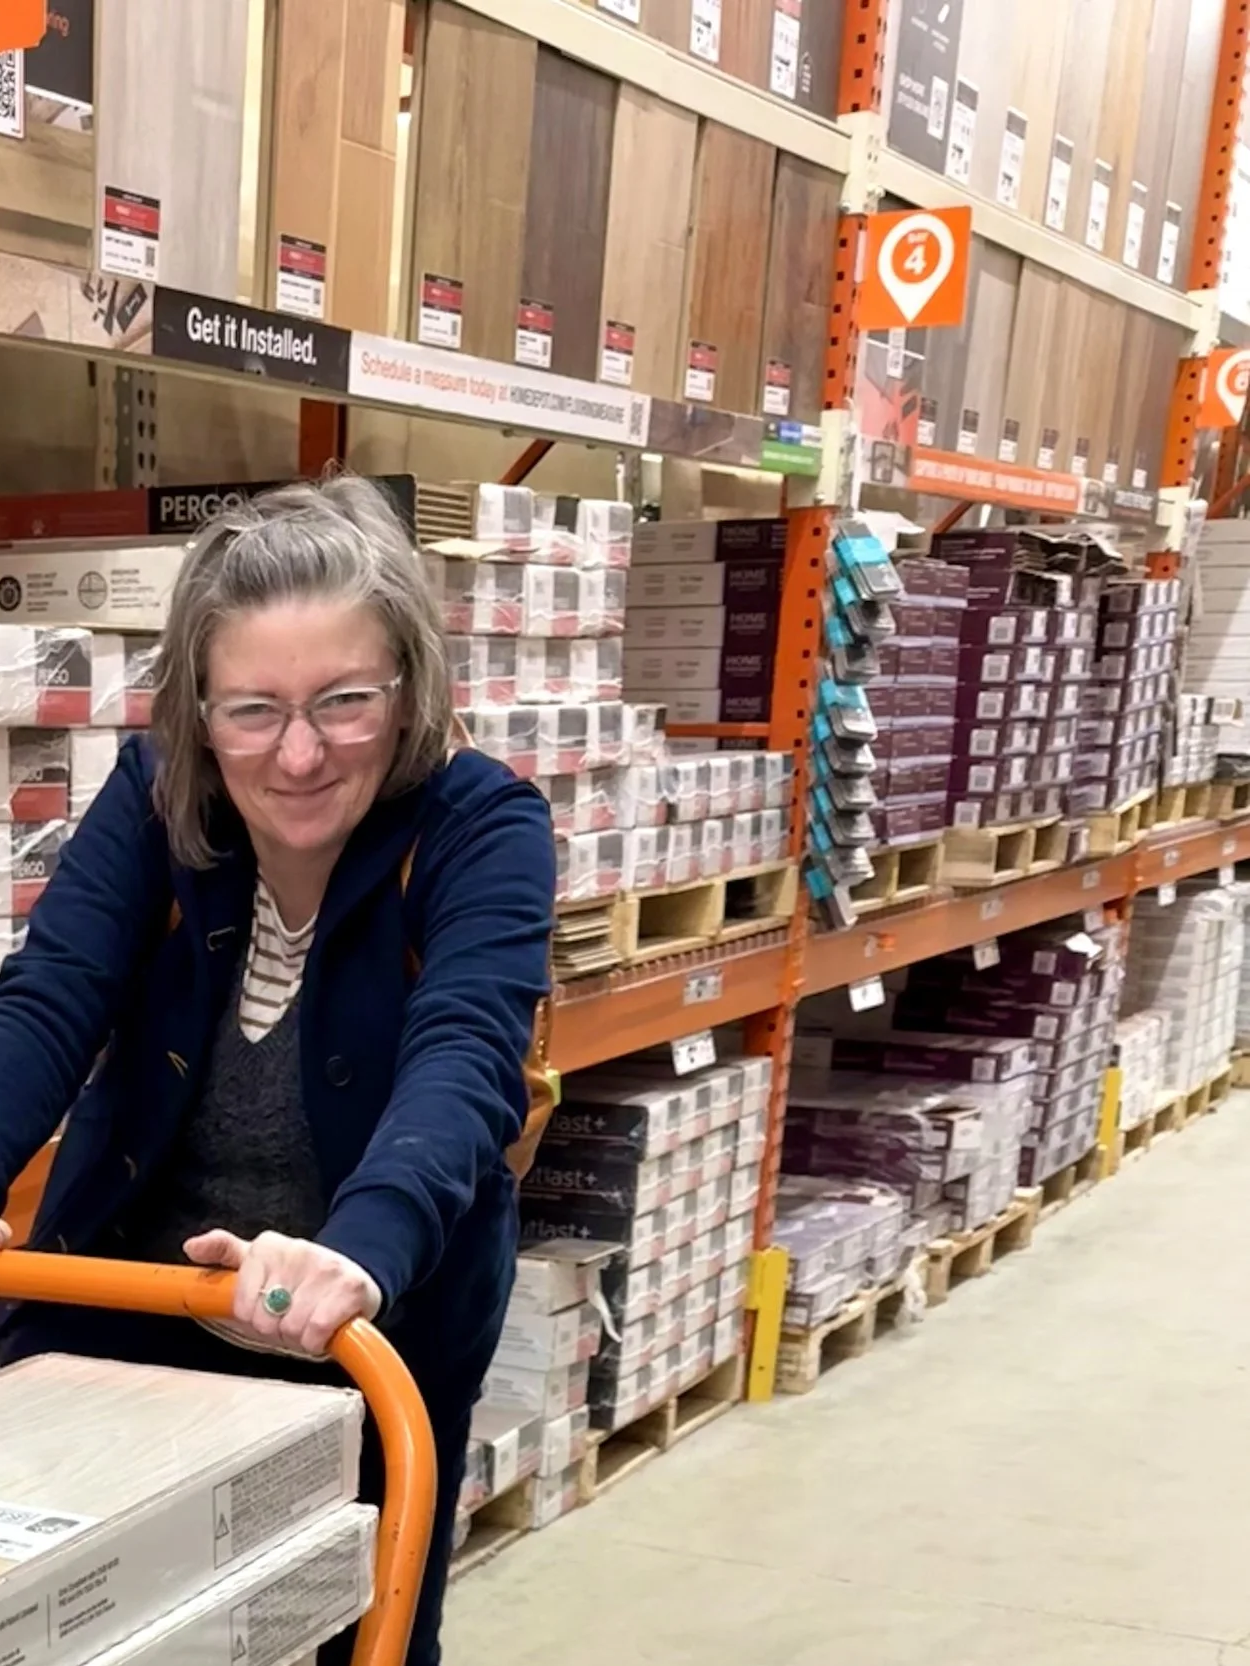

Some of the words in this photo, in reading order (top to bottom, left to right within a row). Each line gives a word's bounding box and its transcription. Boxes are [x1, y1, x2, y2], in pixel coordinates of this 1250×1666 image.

[903, 244, 927, 275] 4
[186, 306, 221, 345] Get
[224, 314, 237, 349] it
[240, 319, 318, 366] Installed.
[360, 351, 412, 383] Schedule
[414, 367, 421, 385] a
[470, 376, 497, 404] today
